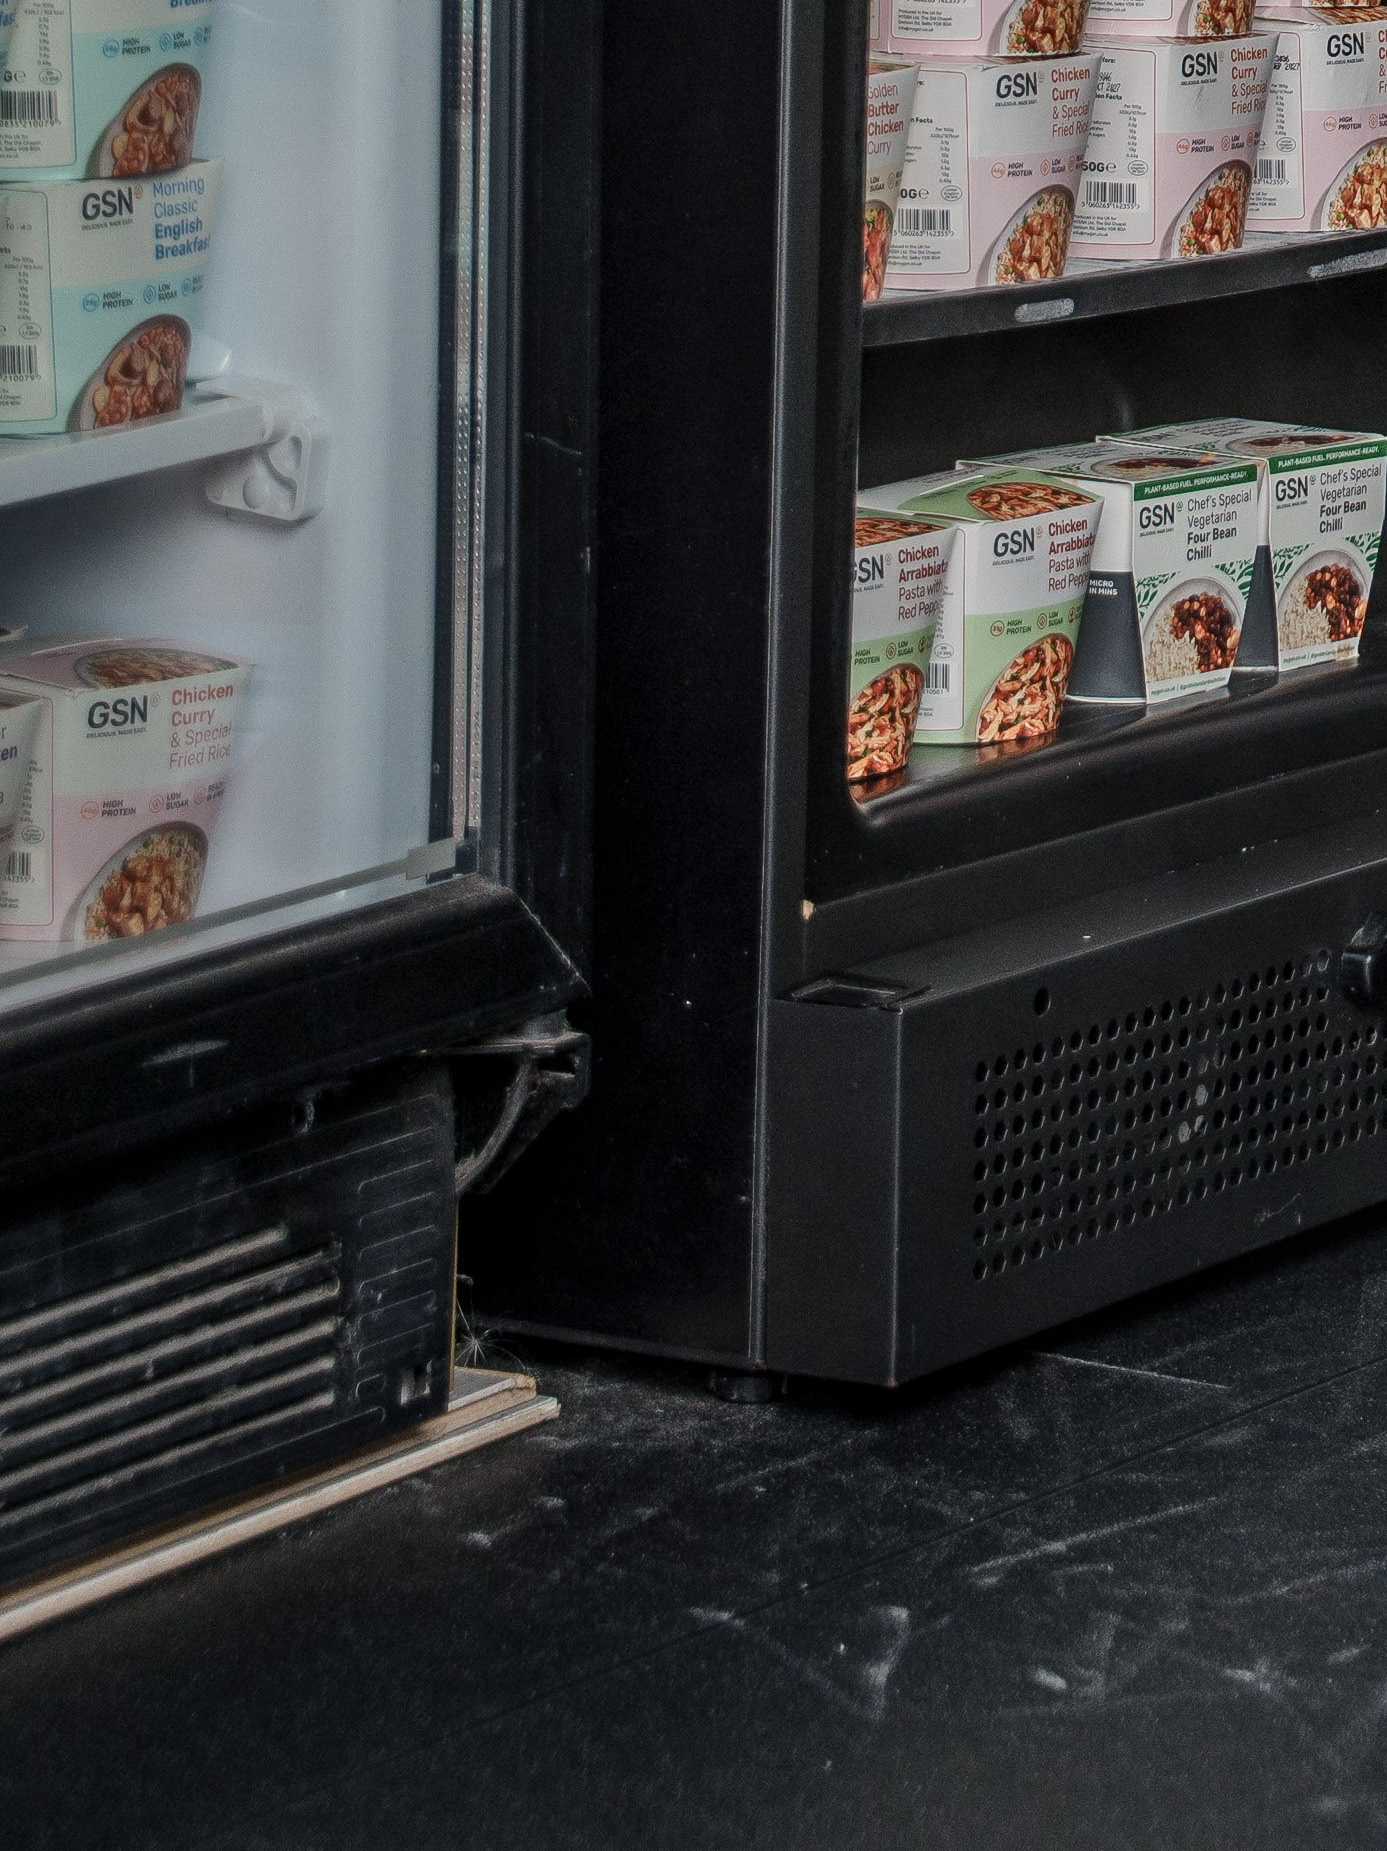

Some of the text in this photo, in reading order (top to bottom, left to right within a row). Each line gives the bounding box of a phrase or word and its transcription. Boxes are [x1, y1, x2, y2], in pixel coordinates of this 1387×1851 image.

[153, 177, 205, 197] Morning
[82, 187, 134, 221] GSN
[154, 200, 198, 219] Classic
[155, 218, 202, 240] English
[1187, 489, 1252, 512] Chef's Special
[1140, 501, 1175, 530] GSN
[1187, 509, 1237, 529] Vegetarian
[1048, 517, 1088, 537] Chicken
[1187, 527, 1237, 545] Four Bean
[993, 526, 1035, 558] GSN
[1187, 544, 1213, 561] Chilli
[1089, 579, 1114, 588] MICRO
[1089, 587, 1118, 596] IN MINS
[171, 684, 234, 707] Chicken
[87, 695, 148, 729] GSN
[171, 708, 216, 727] Curry
[170, 722, 232, 748] & Special
[169, 750, 205, 770] Fried
[101, 807, 137, 818] PROTEIN
[103, 800, 124, 809] HIGH
